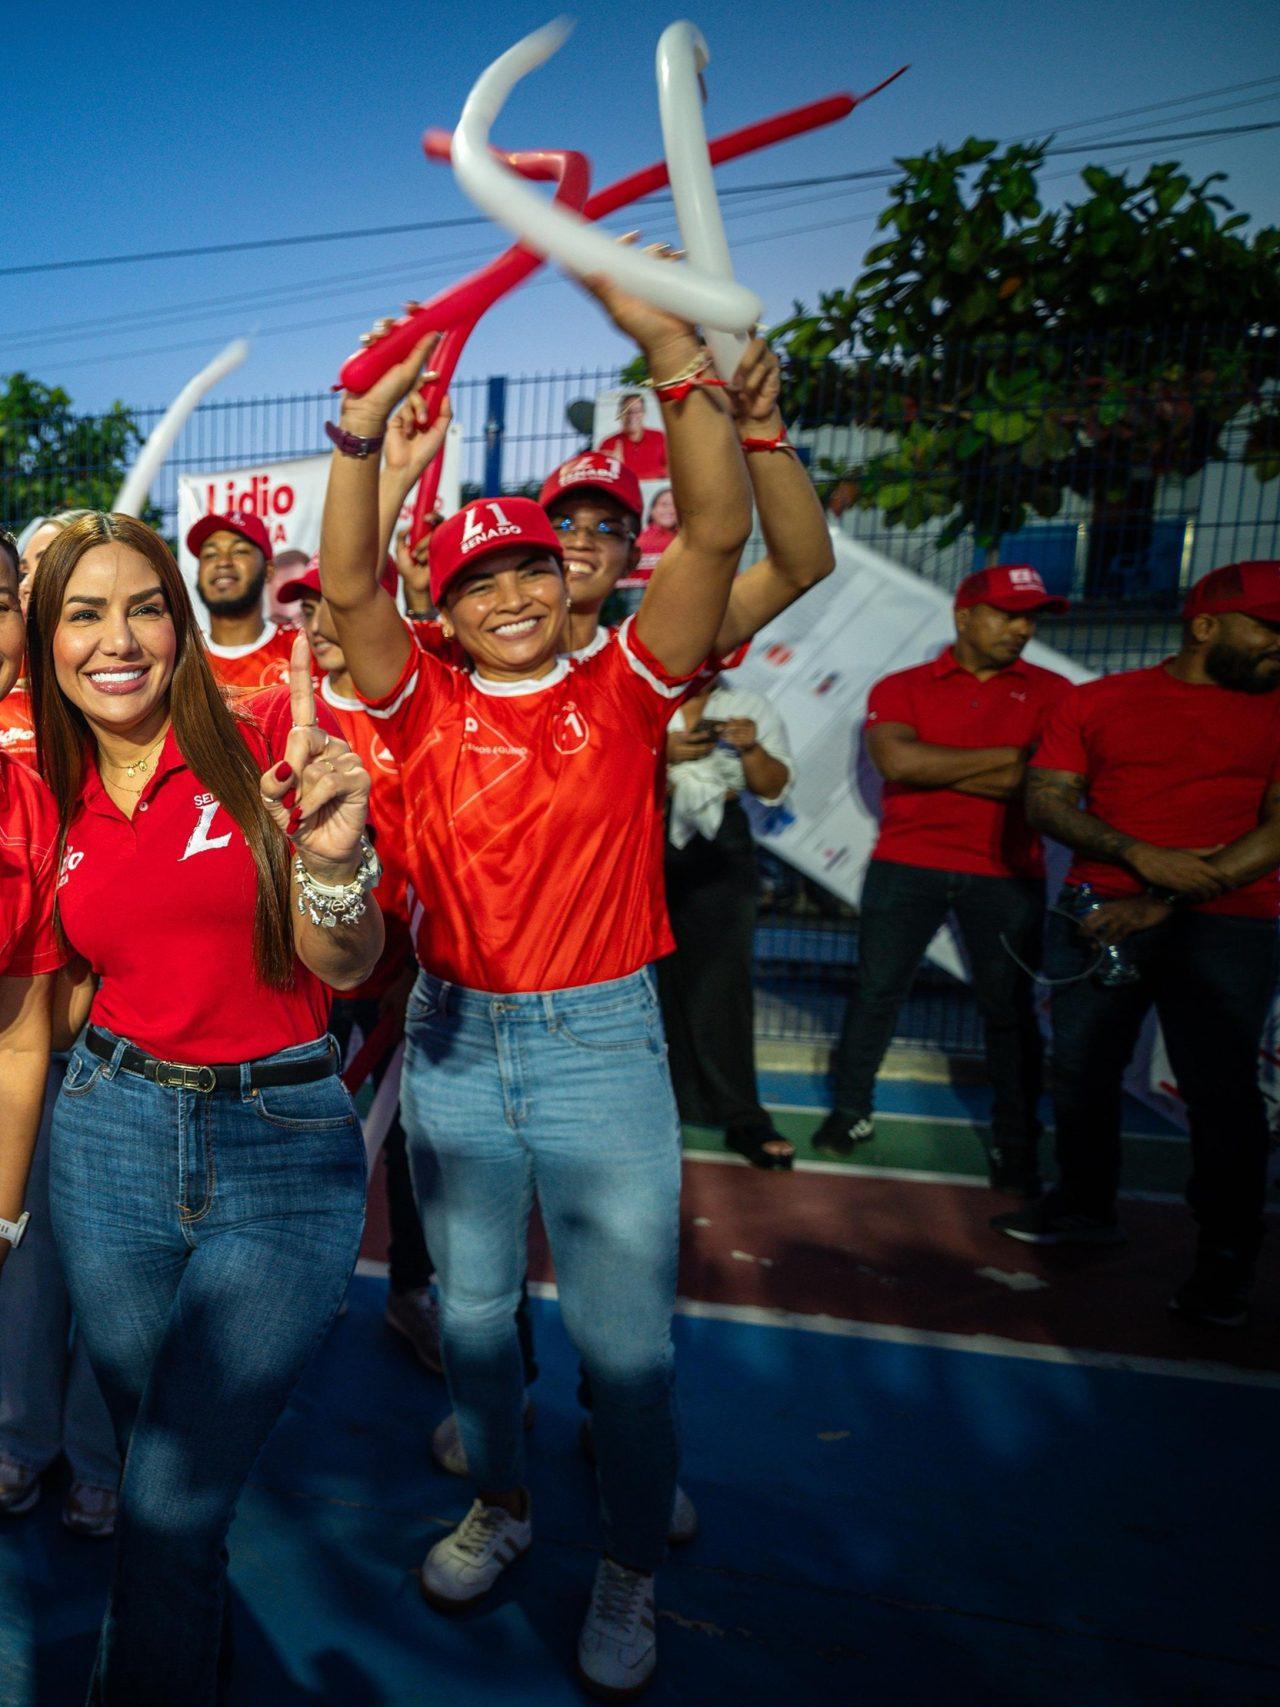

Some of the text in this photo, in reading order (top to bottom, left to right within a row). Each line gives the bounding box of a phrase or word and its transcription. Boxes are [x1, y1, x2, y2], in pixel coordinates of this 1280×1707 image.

[461, 502, 512, 543] L1
[461, 525, 522, 554] SENADO
[177, 800, 232, 861] L
